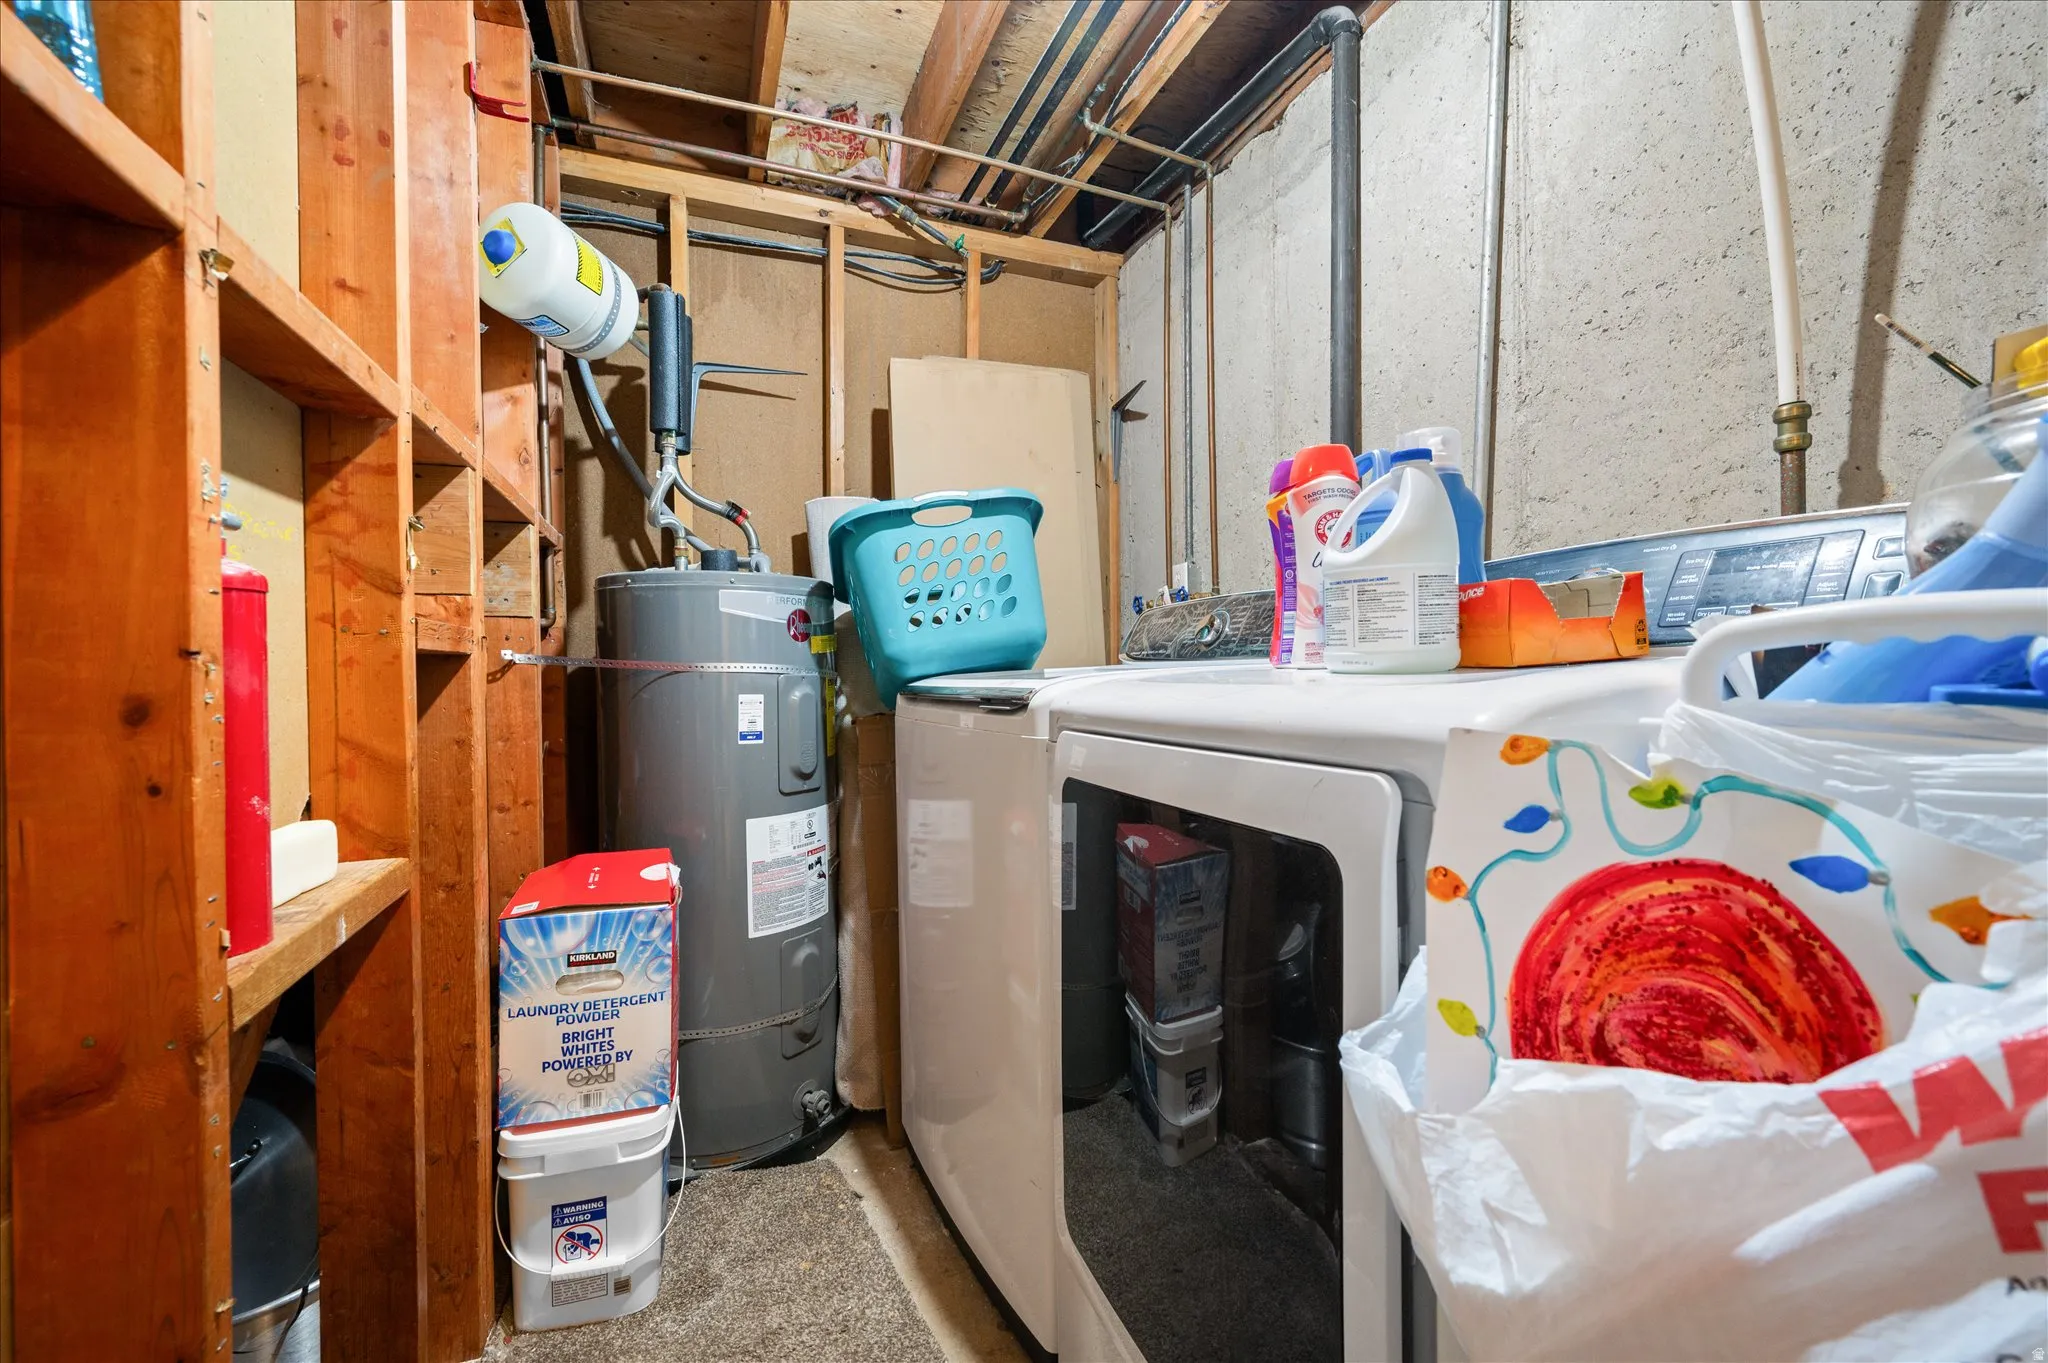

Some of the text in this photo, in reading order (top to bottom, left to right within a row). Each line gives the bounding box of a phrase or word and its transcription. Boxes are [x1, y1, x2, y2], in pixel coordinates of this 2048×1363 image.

[1302, 487, 1336, 500] TARGETS
[1308, 496, 1322, 504] FIRST
[1317, 518, 1328, 534] ARM
[1325, 512, 1333, 520] &
[1458, 585, 1485, 601] ounce
[569, 951, 616, 962] KIRKLAND
[507, 990, 667, 1019] LAUNDRY DETERGENT
[556, 1008, 621, 1026] POWDER
[562, 1026, 615, 1044] BRIGHT
[560, 1039, 615, 1058] WHITES
[541, 1049, 634, 1073] POWERED BY
[566, 1062, 616, 1088] OXI
[563, 1200, 604, 1214] WARNING
[563, 1213, 591, 1225] AVISO
